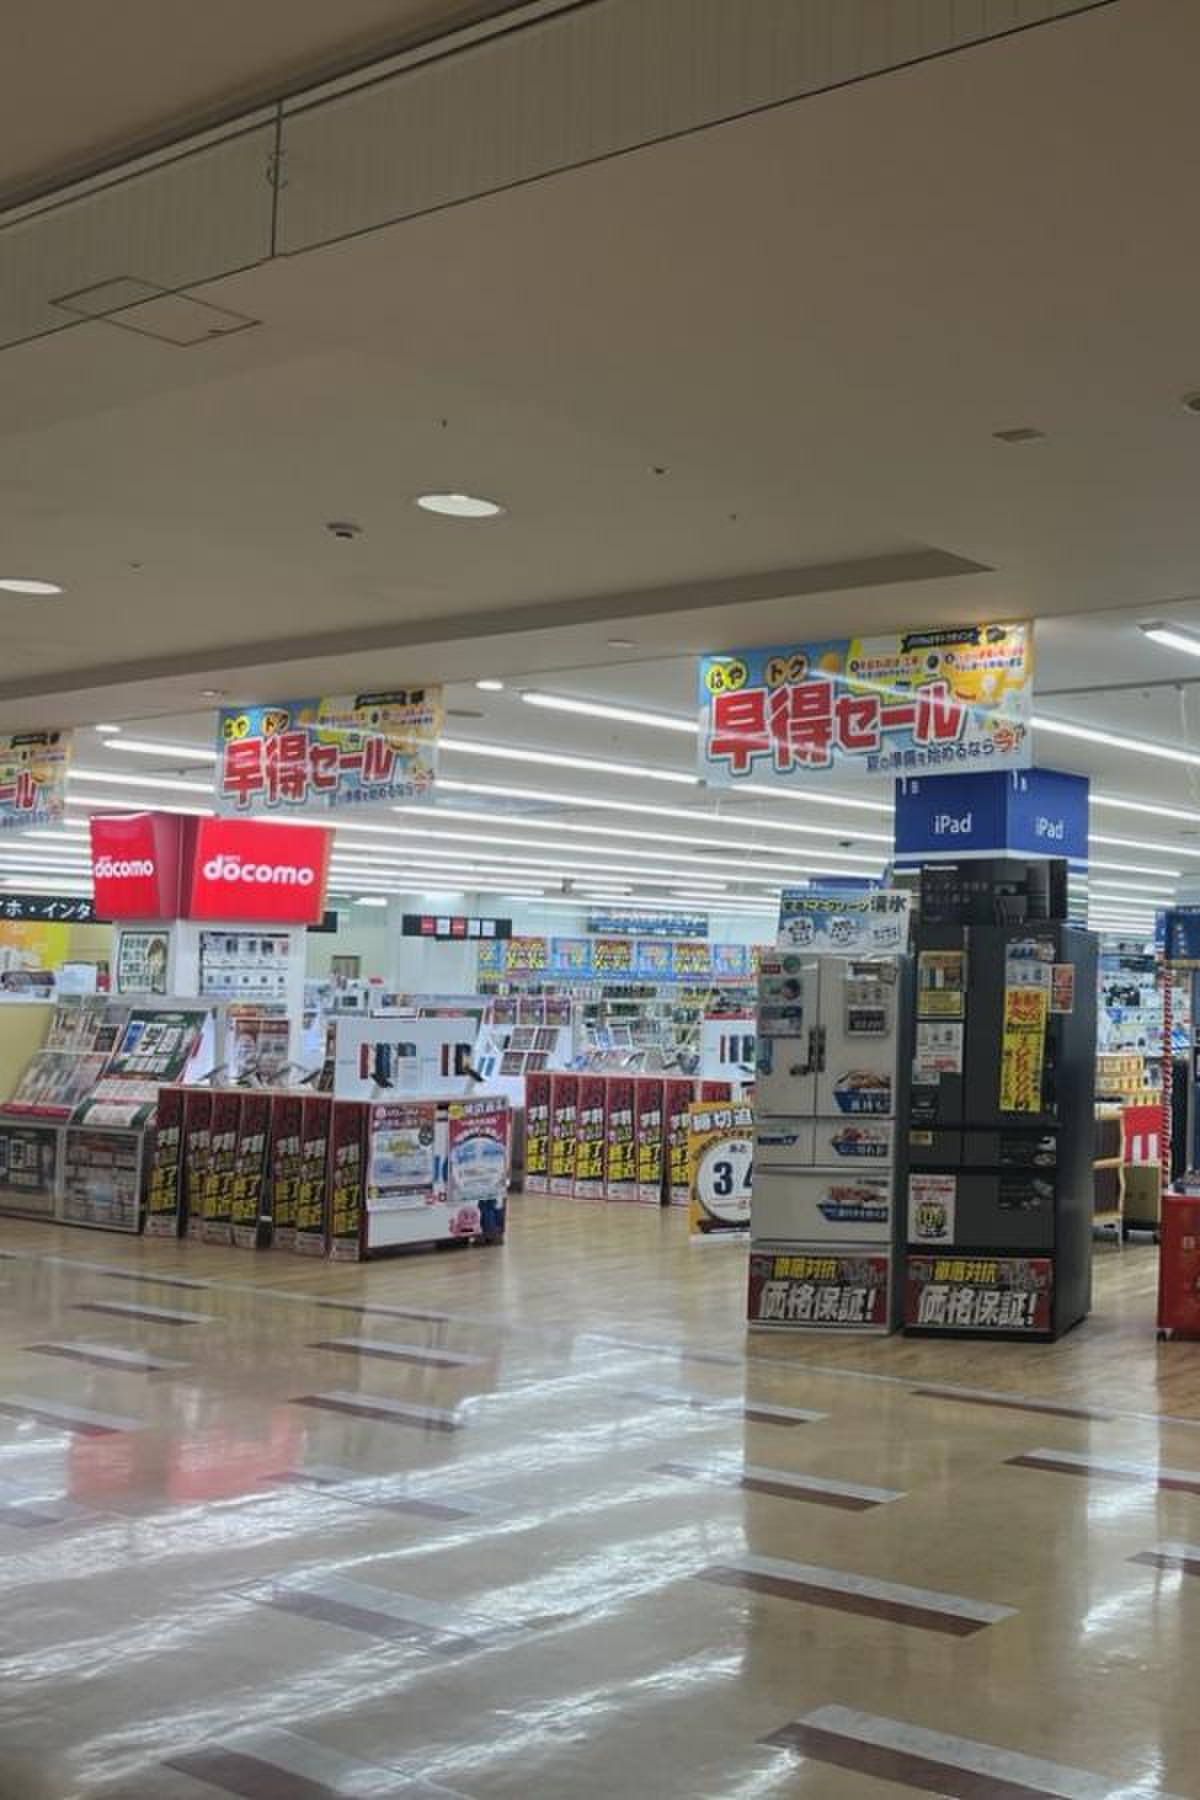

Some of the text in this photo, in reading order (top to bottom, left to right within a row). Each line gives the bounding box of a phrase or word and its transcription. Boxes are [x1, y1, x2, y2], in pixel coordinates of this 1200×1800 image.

[709, 682, 965, 772] 早得セール
[223, 736, 394, 805] 早得セール
[934, 813, 972, 834] iPad
[1036, 816, 1064, 839] iPad
[203, 854, 314, 885] docomo
[758, 1281, 876, 1321] 価格保証!
[916, 1284, 1037, 1327] 価格保証!
